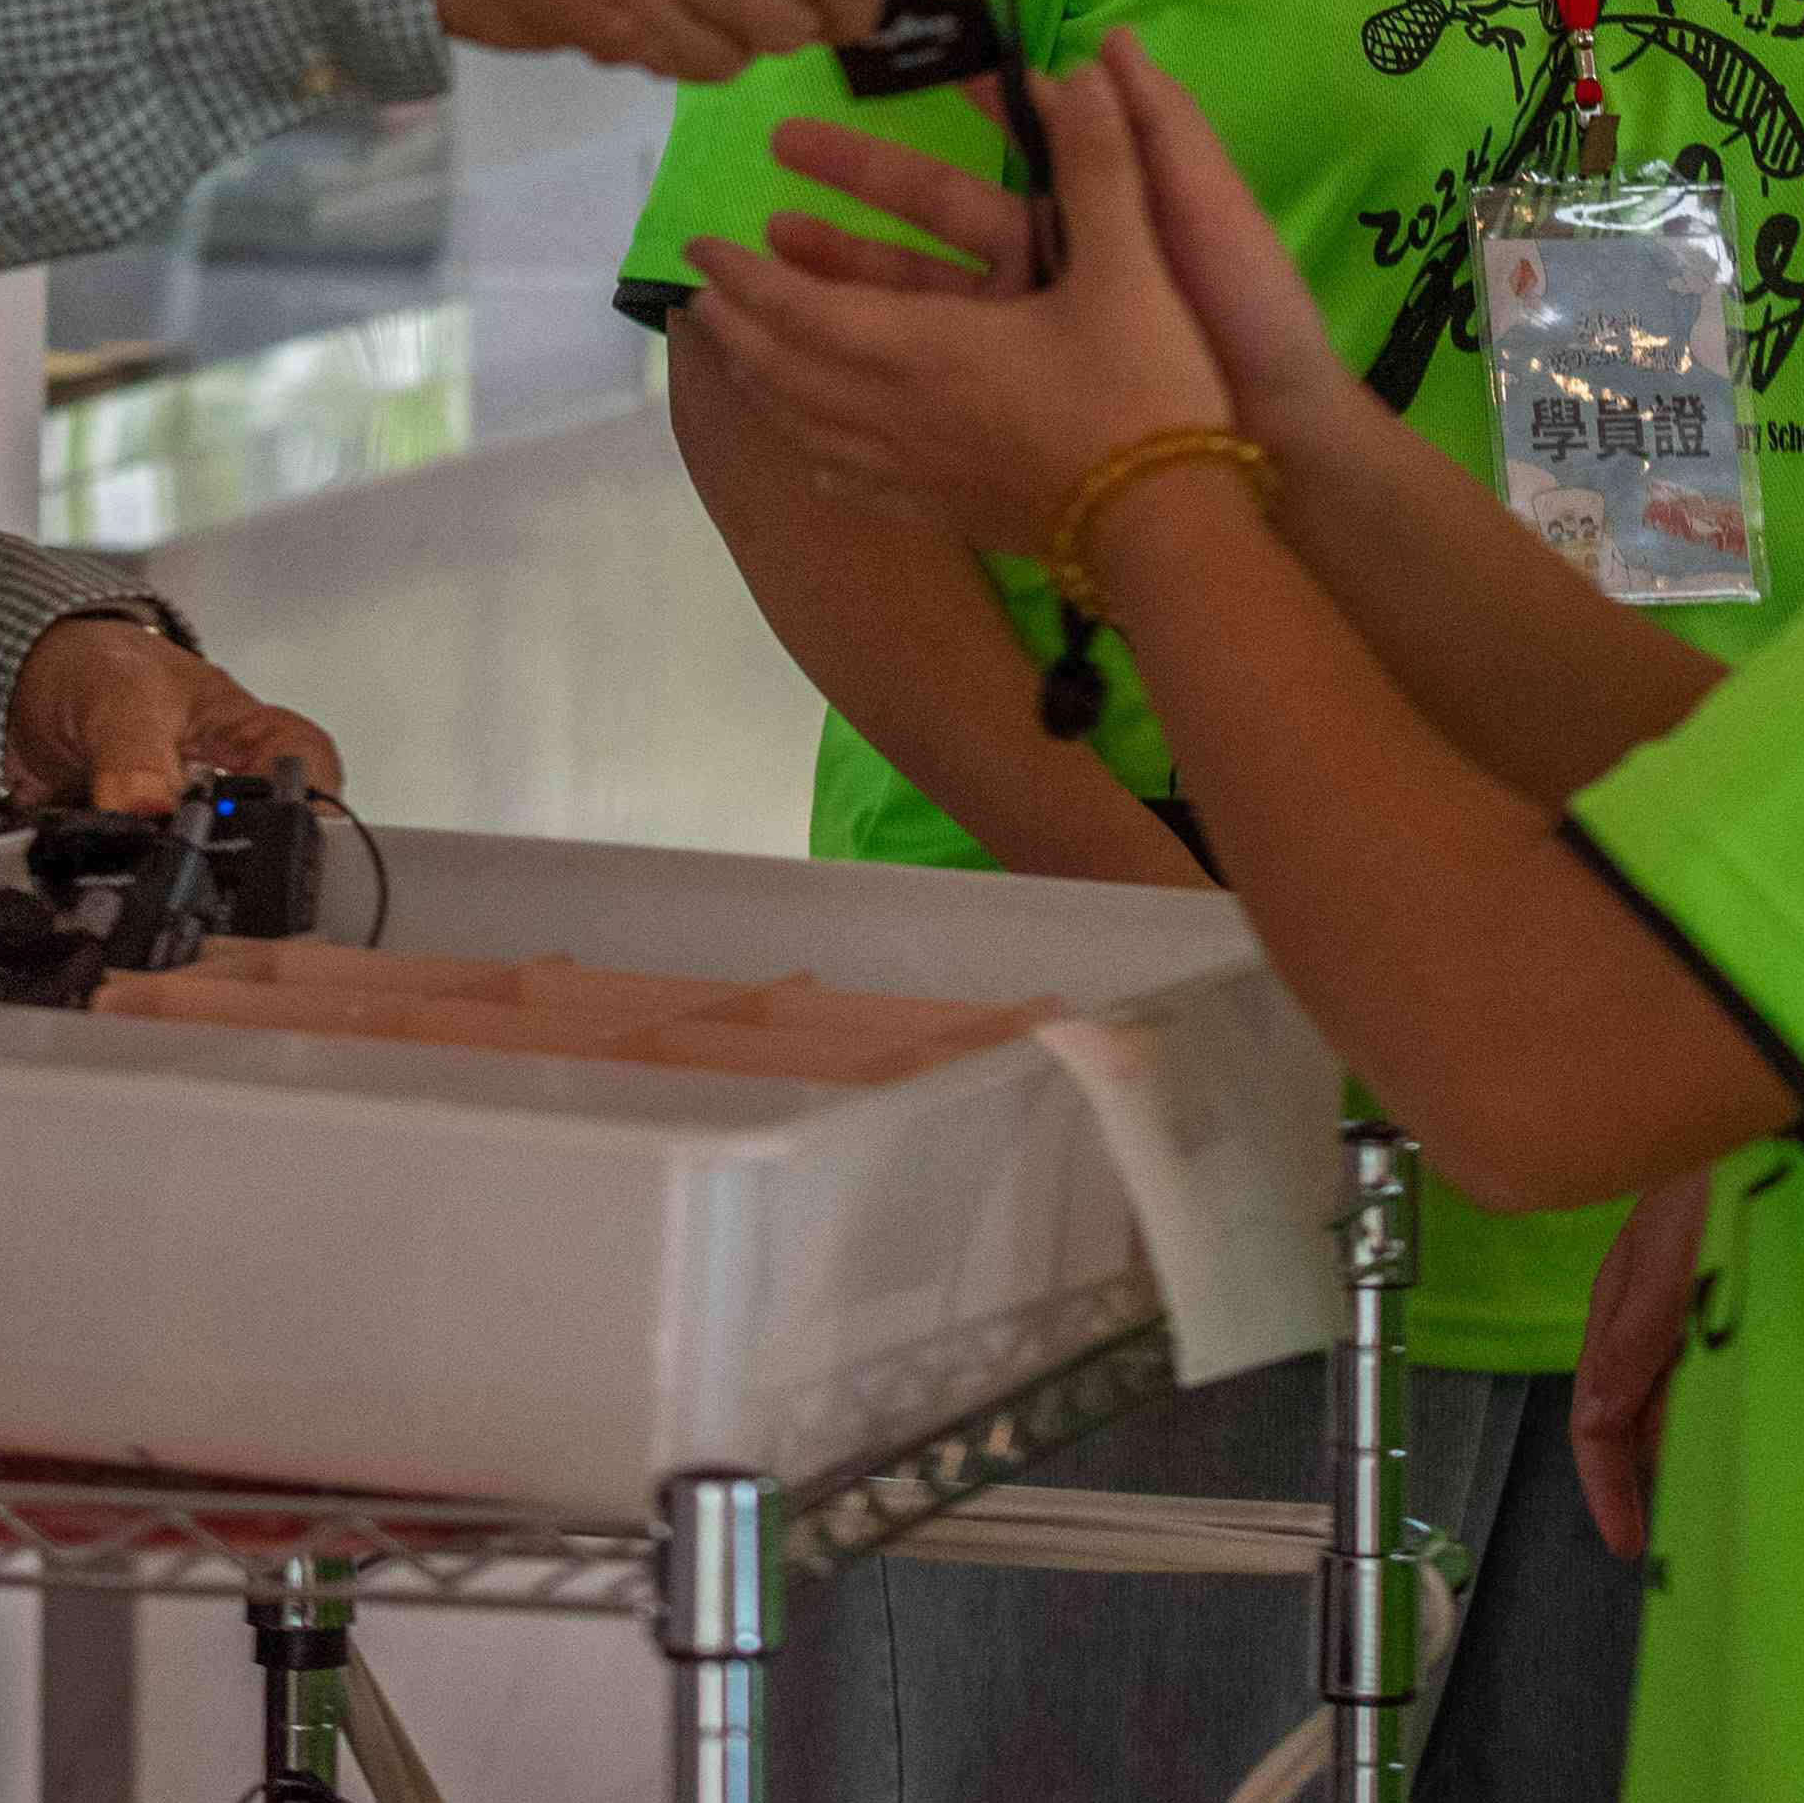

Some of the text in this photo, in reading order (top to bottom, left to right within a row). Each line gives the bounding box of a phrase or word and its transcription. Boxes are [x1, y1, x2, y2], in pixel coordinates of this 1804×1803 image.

[1358, 126, 1490, 266] 2024
[1531, 395, 1712, 463] 學員證
